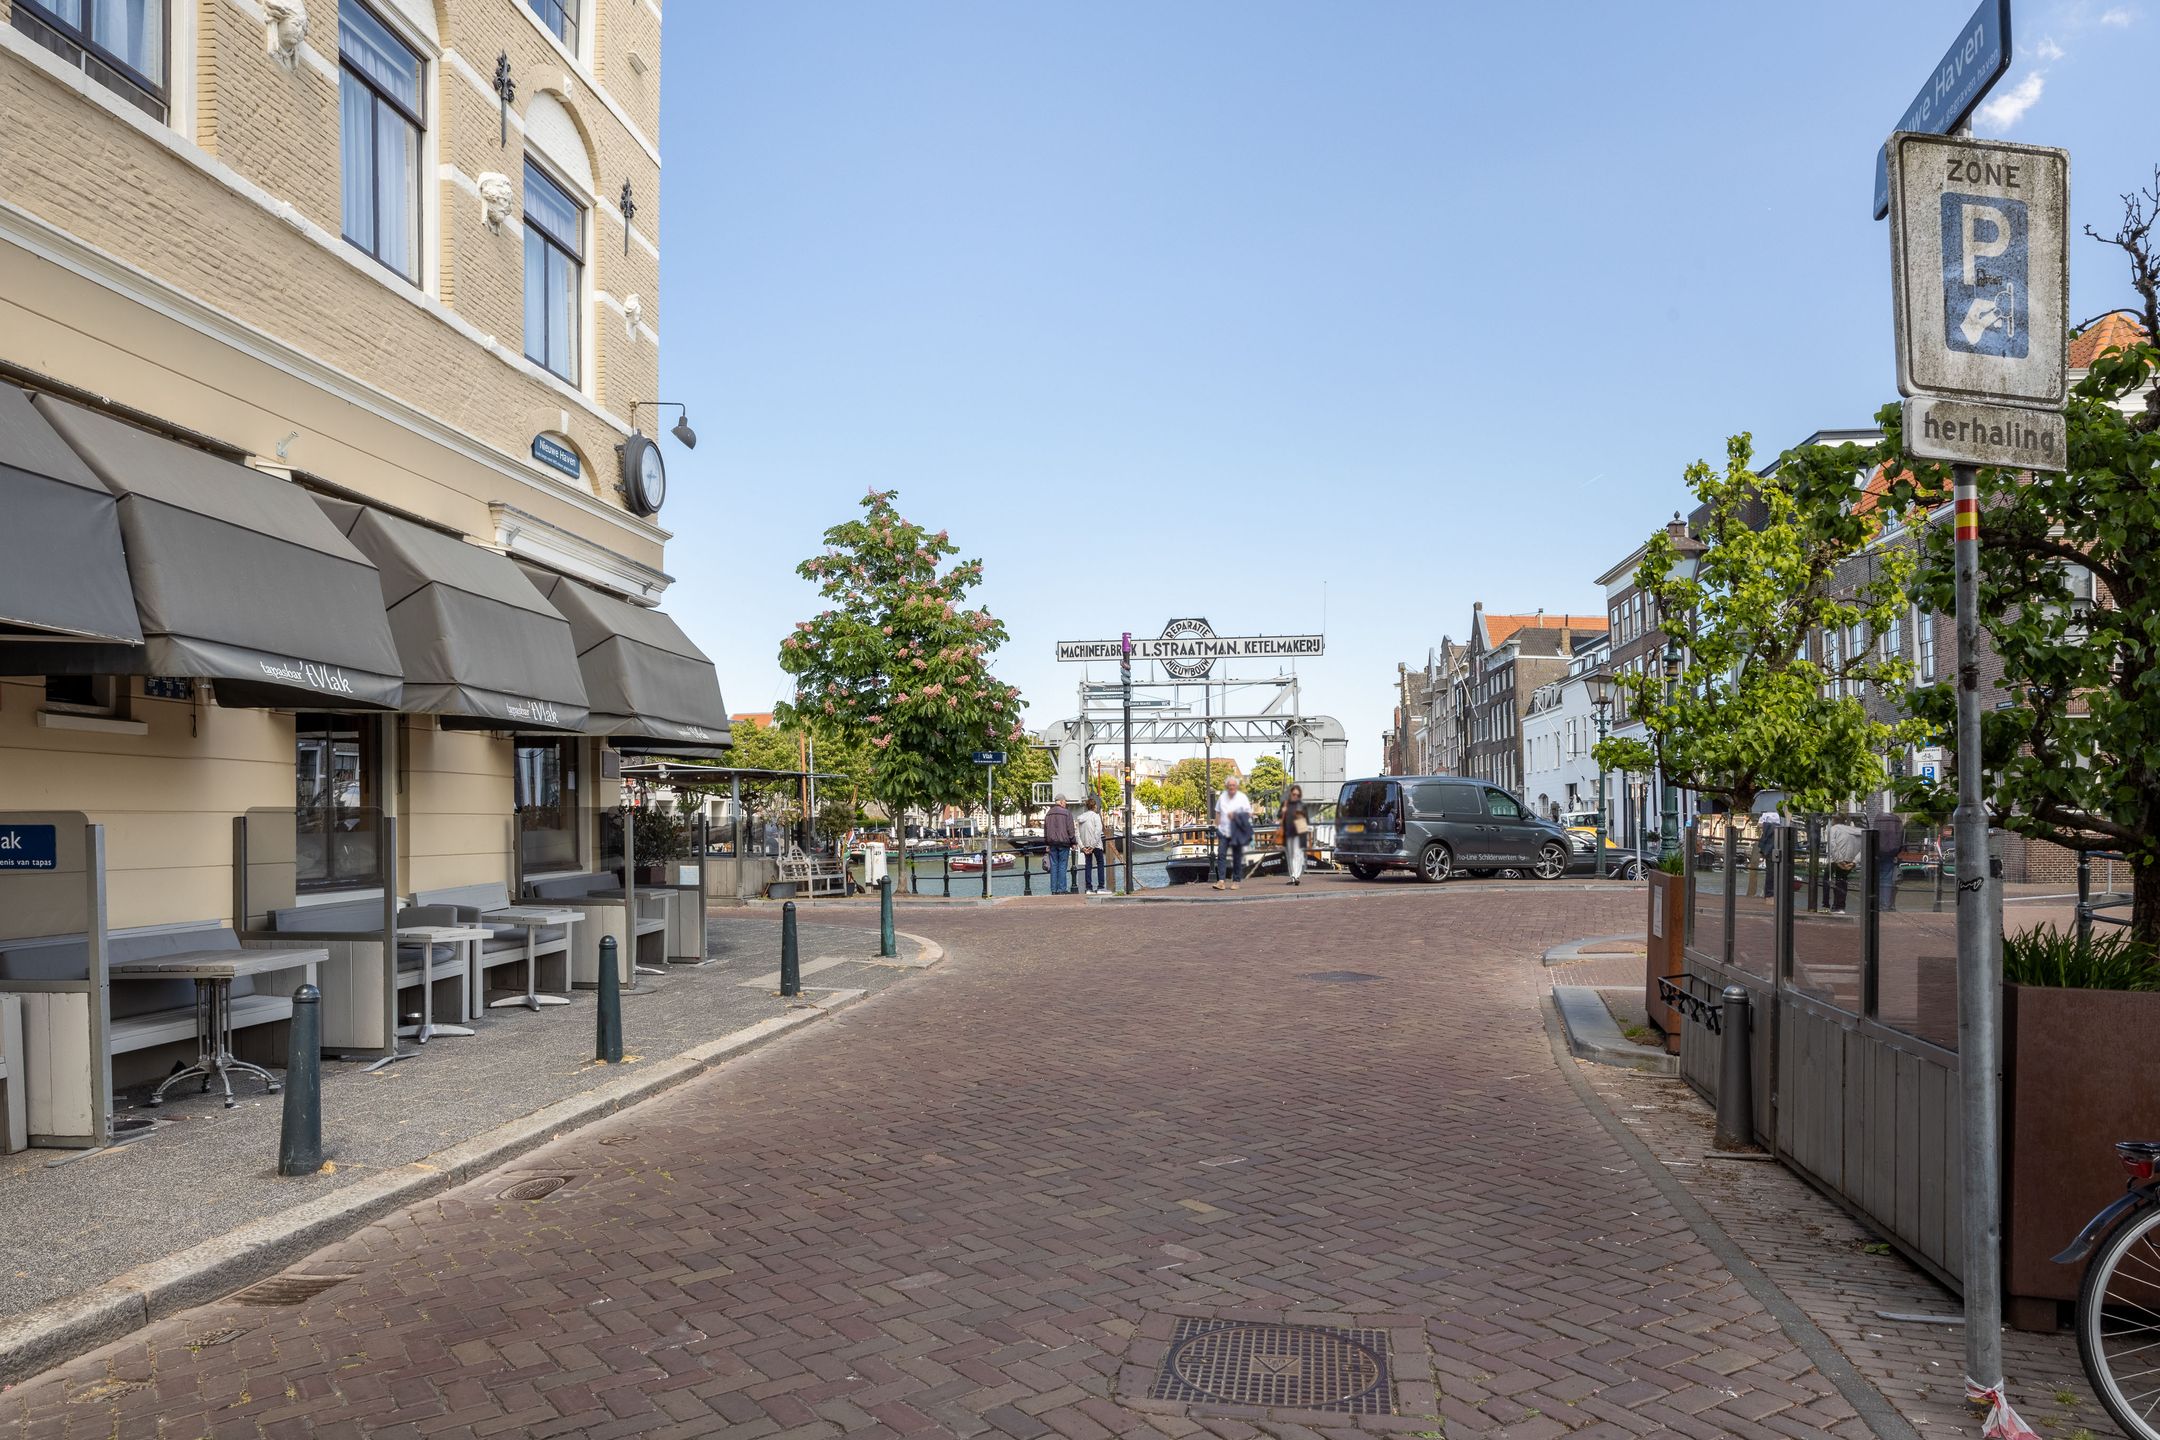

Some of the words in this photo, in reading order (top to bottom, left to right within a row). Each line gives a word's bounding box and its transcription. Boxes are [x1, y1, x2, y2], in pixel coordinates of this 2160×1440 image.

[1935, 23, 1984, 107] Haven
[1945, 76, 1976, 124] gegraven
[1977, 48, 1999, 81] haven
[1947, 159, 2021, 188] ZONE
[1961, 203, 2011, 285] P
[1923, 411, 2055, 459] herhaling
[540, 439, 559, 458] Nieuwe
[559, 450, 576, 467] Haven
[1165, 621, 1211, 639] REPARATIE
[1060, 643, 1137, 658] MACHINEFABRK
[1244, 639, 1321, 654] KETELMAKERIJ
[260, 661, 303, 681] tapasbar
[1165, 659, 1211, 677] NIEUWBOUW
[32, 859, 51, 867] tapas
[1478, 853, 1517, 861] Schilderwerken
